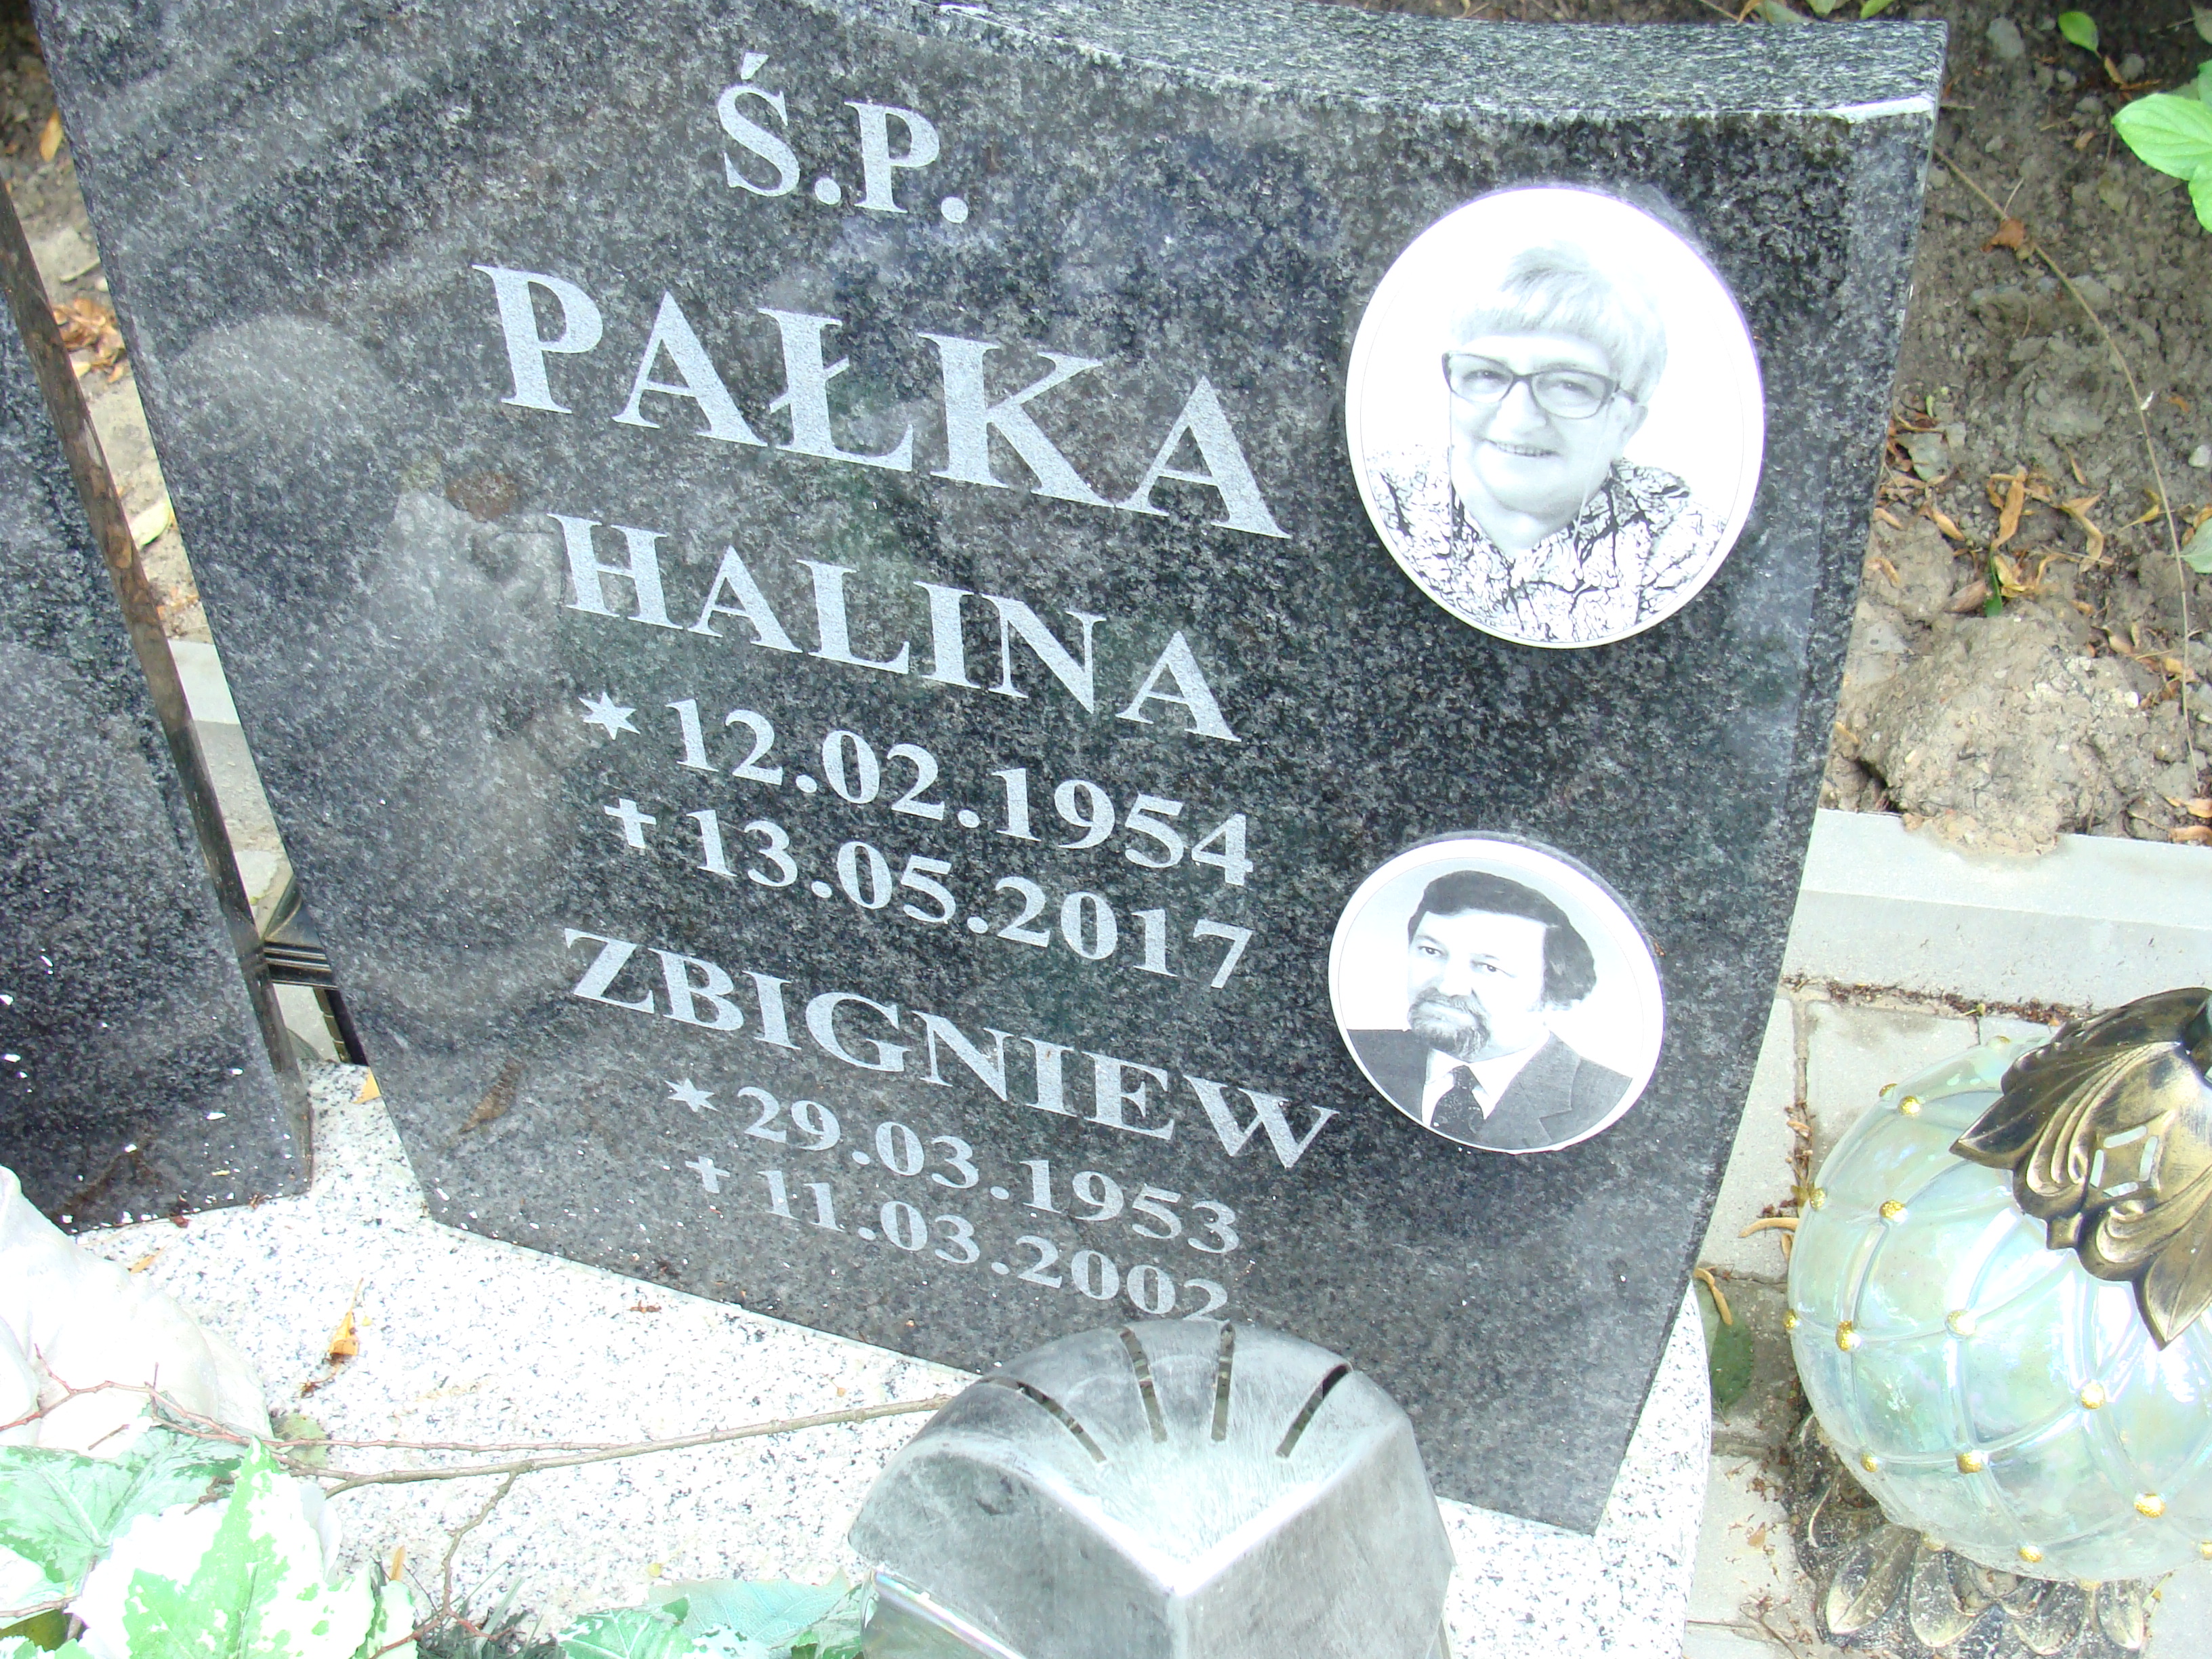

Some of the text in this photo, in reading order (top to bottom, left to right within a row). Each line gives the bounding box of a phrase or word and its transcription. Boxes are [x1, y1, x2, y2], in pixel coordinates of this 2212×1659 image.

[718, 52, 968, 223] Ś.P.
[472, 264, 1290, 539] PAŁKA
[548, 514, 1242, 742] HALINA
[666, 698, 1253, 886] 12.02.1954
[687, 811, 1253, 990] 13.05.2017
[564, 929, 1340, 1169] ZBIGNIEW
[736, 1087, 1240, 1254] 29.03.1953
[759, 1170, 1229, 1322] 11.03.2002
